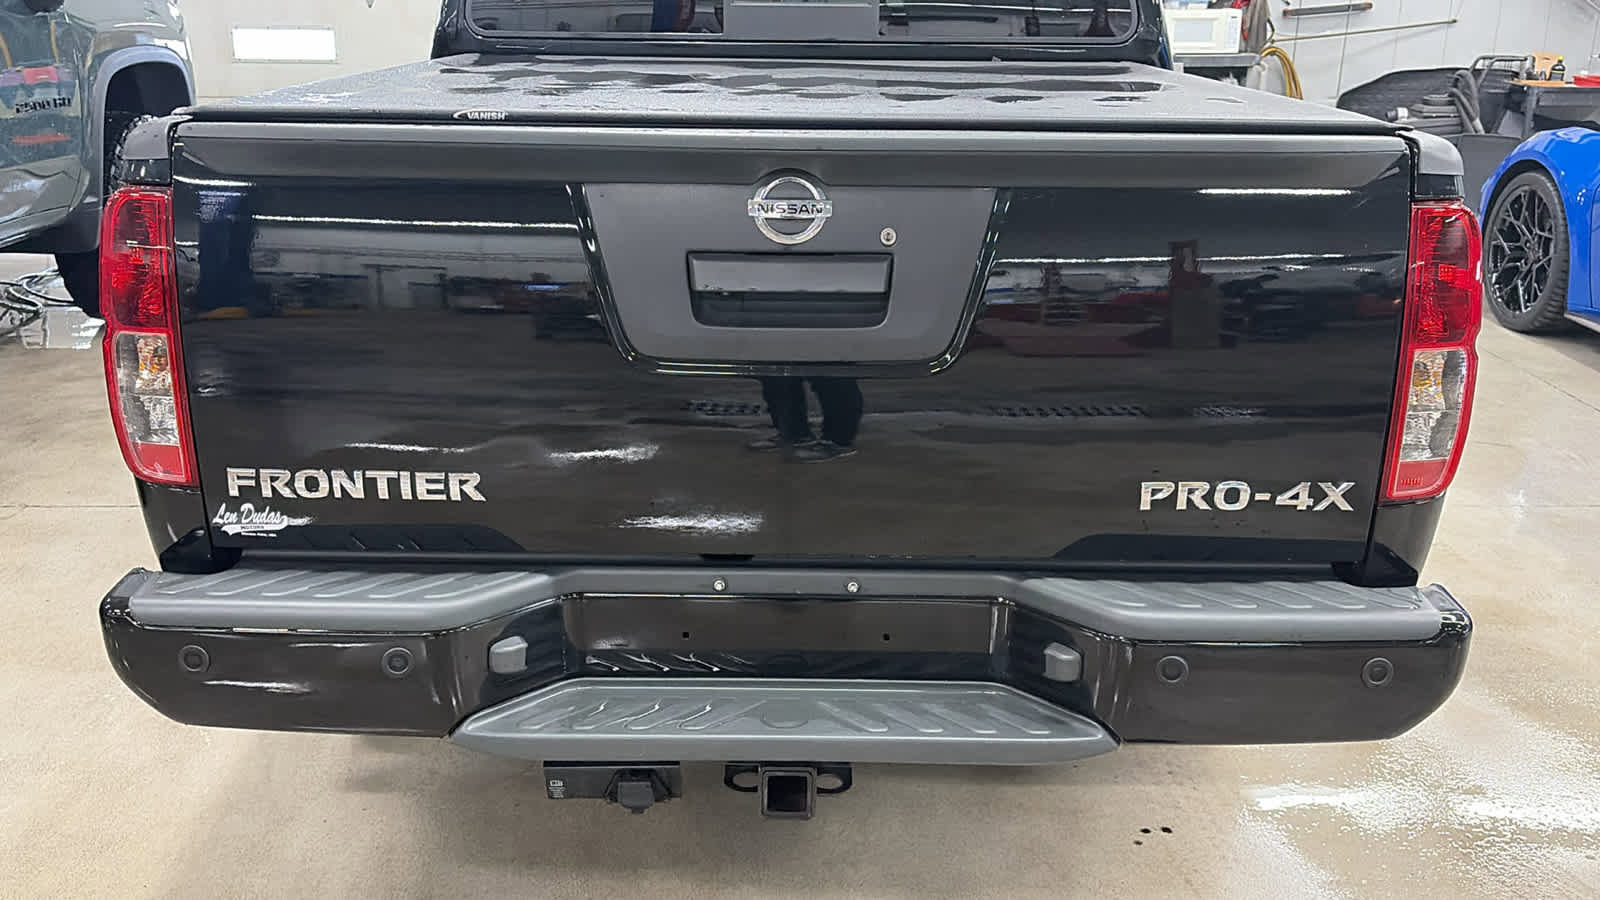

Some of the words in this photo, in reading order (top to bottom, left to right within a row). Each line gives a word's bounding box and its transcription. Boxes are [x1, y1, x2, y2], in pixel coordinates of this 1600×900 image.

[467, 111, 505, 120] VANISH
[757, 203, 823, 214] NISSAN
[226, 467, 487, 501] FRONTIER
[1139, 481, 1356, 511] PRO-4X
[212, 502, 239, 524] Len
[240, 502, 281, 524] Dudas
